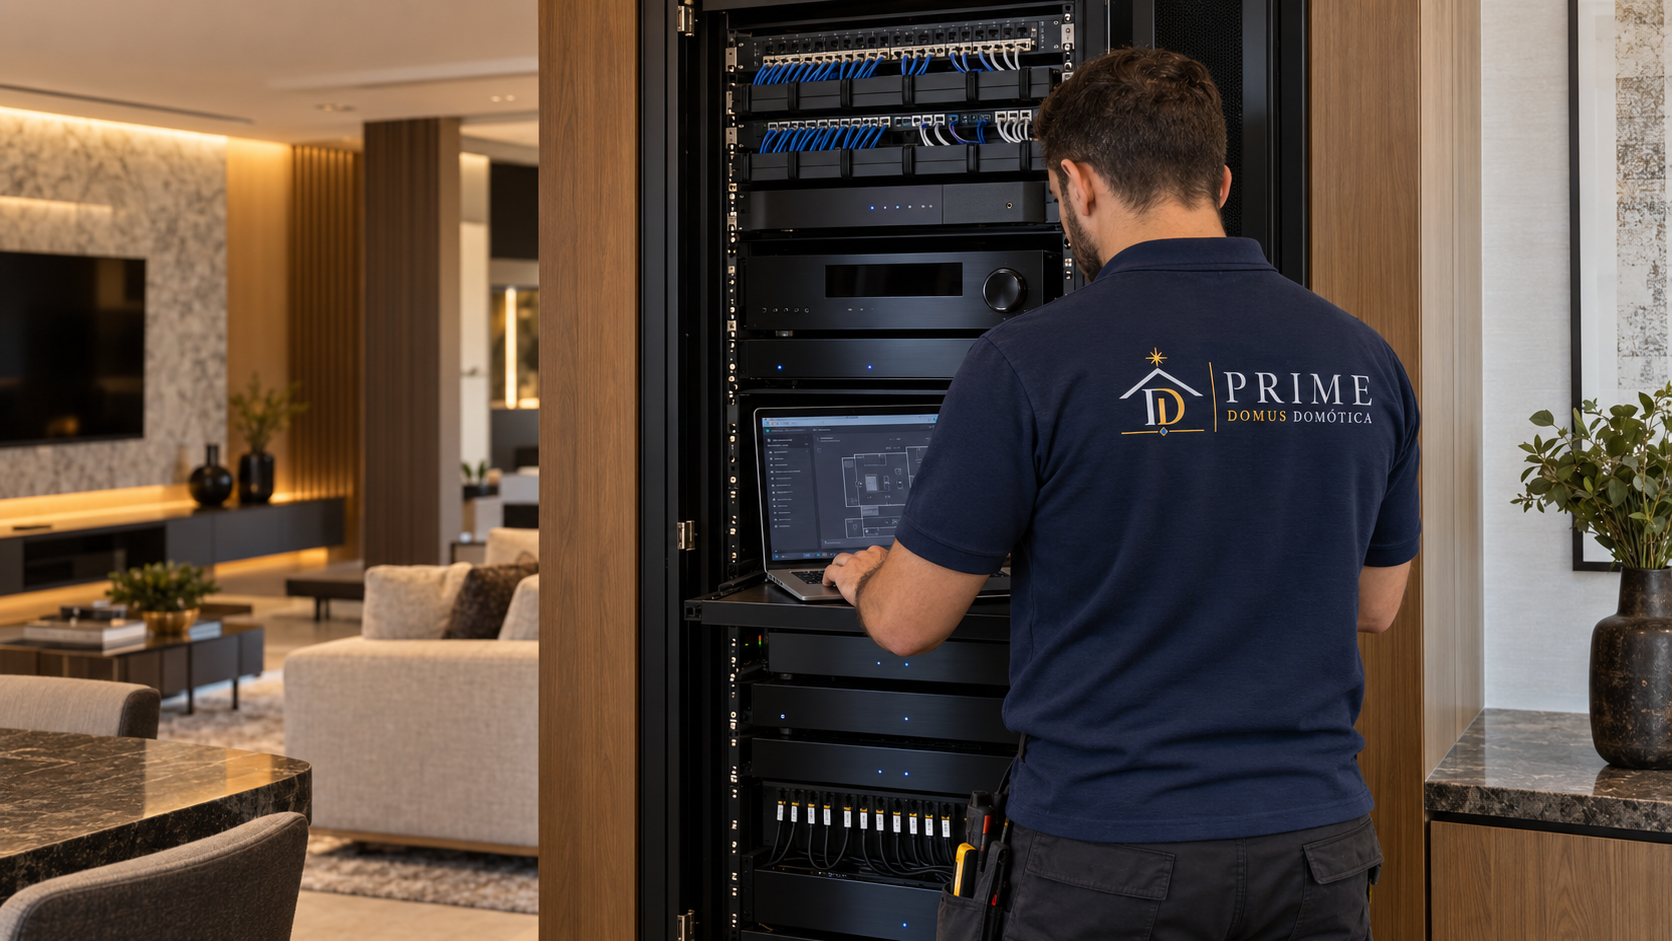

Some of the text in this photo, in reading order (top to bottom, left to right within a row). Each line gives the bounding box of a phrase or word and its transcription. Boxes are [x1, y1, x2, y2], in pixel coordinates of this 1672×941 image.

[1223, 371, 1373, 406] PRIME
[1227, 408, 1373, 424] DOMUS DOMÓTICA
